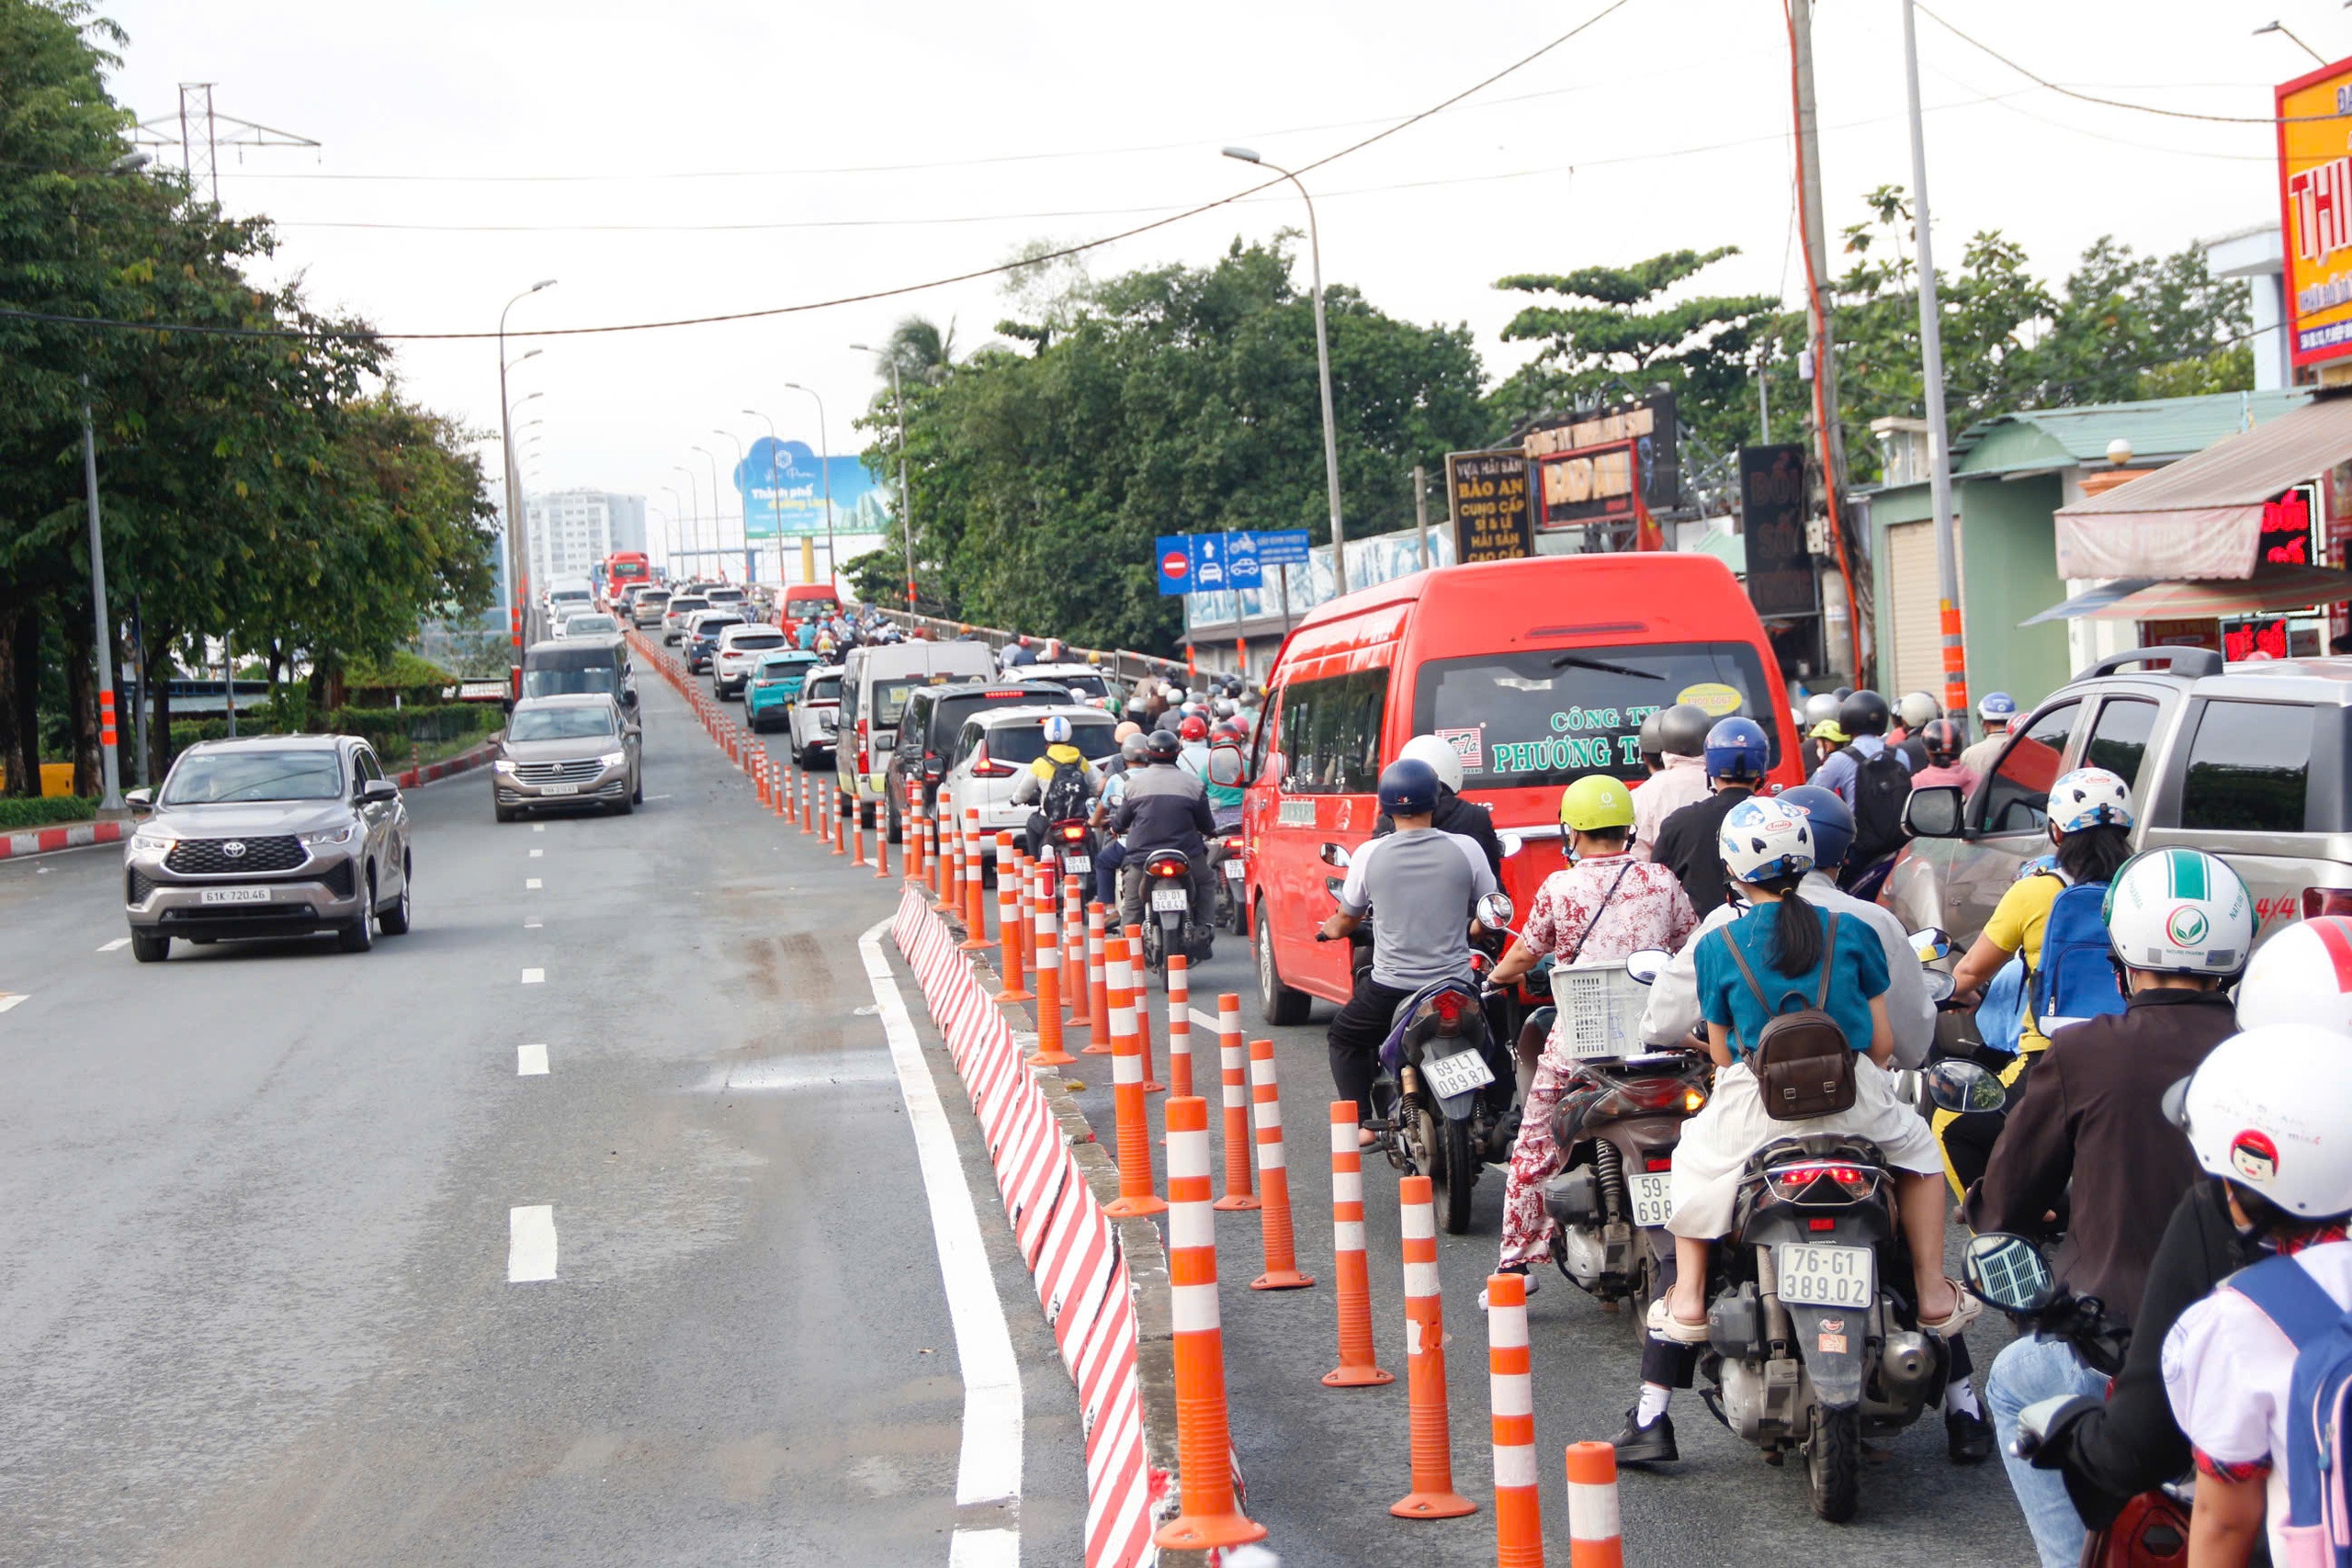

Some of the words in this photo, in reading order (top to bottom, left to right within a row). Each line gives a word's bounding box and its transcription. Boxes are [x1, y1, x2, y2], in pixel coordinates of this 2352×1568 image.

[1481, 458, 1499, 475] HẢI
[1458, 476, 1495, 498] BẢO
[1498, 479, 1523, 496] AN
[1460, 502, 1497, 517] CUNG
[1498, 495, 1525, 513] CẤP
[1471, 531, 1492, 548] HẢI
[1495, 529, 1521, 546] SẢN
[1551, 706, 1621, 732] CÔNG
[1626, 705, 1660, 726] TY
[1493, 737, 1612, 773] PHƯƠNG
[206, 889, 266, 902] 61K-720.46
[1434, 1054, 1475, 1077] 69-L1
[1438, 1066, 1487, 1094] 089.87
[1641, 1178, 1670, 1198] 59-
[1638, 1200, 1672, 1222] 698
[1794, 1248, 1854, 1276] 76-G1
[1784, 1274, 1865, 1303] 389.02
